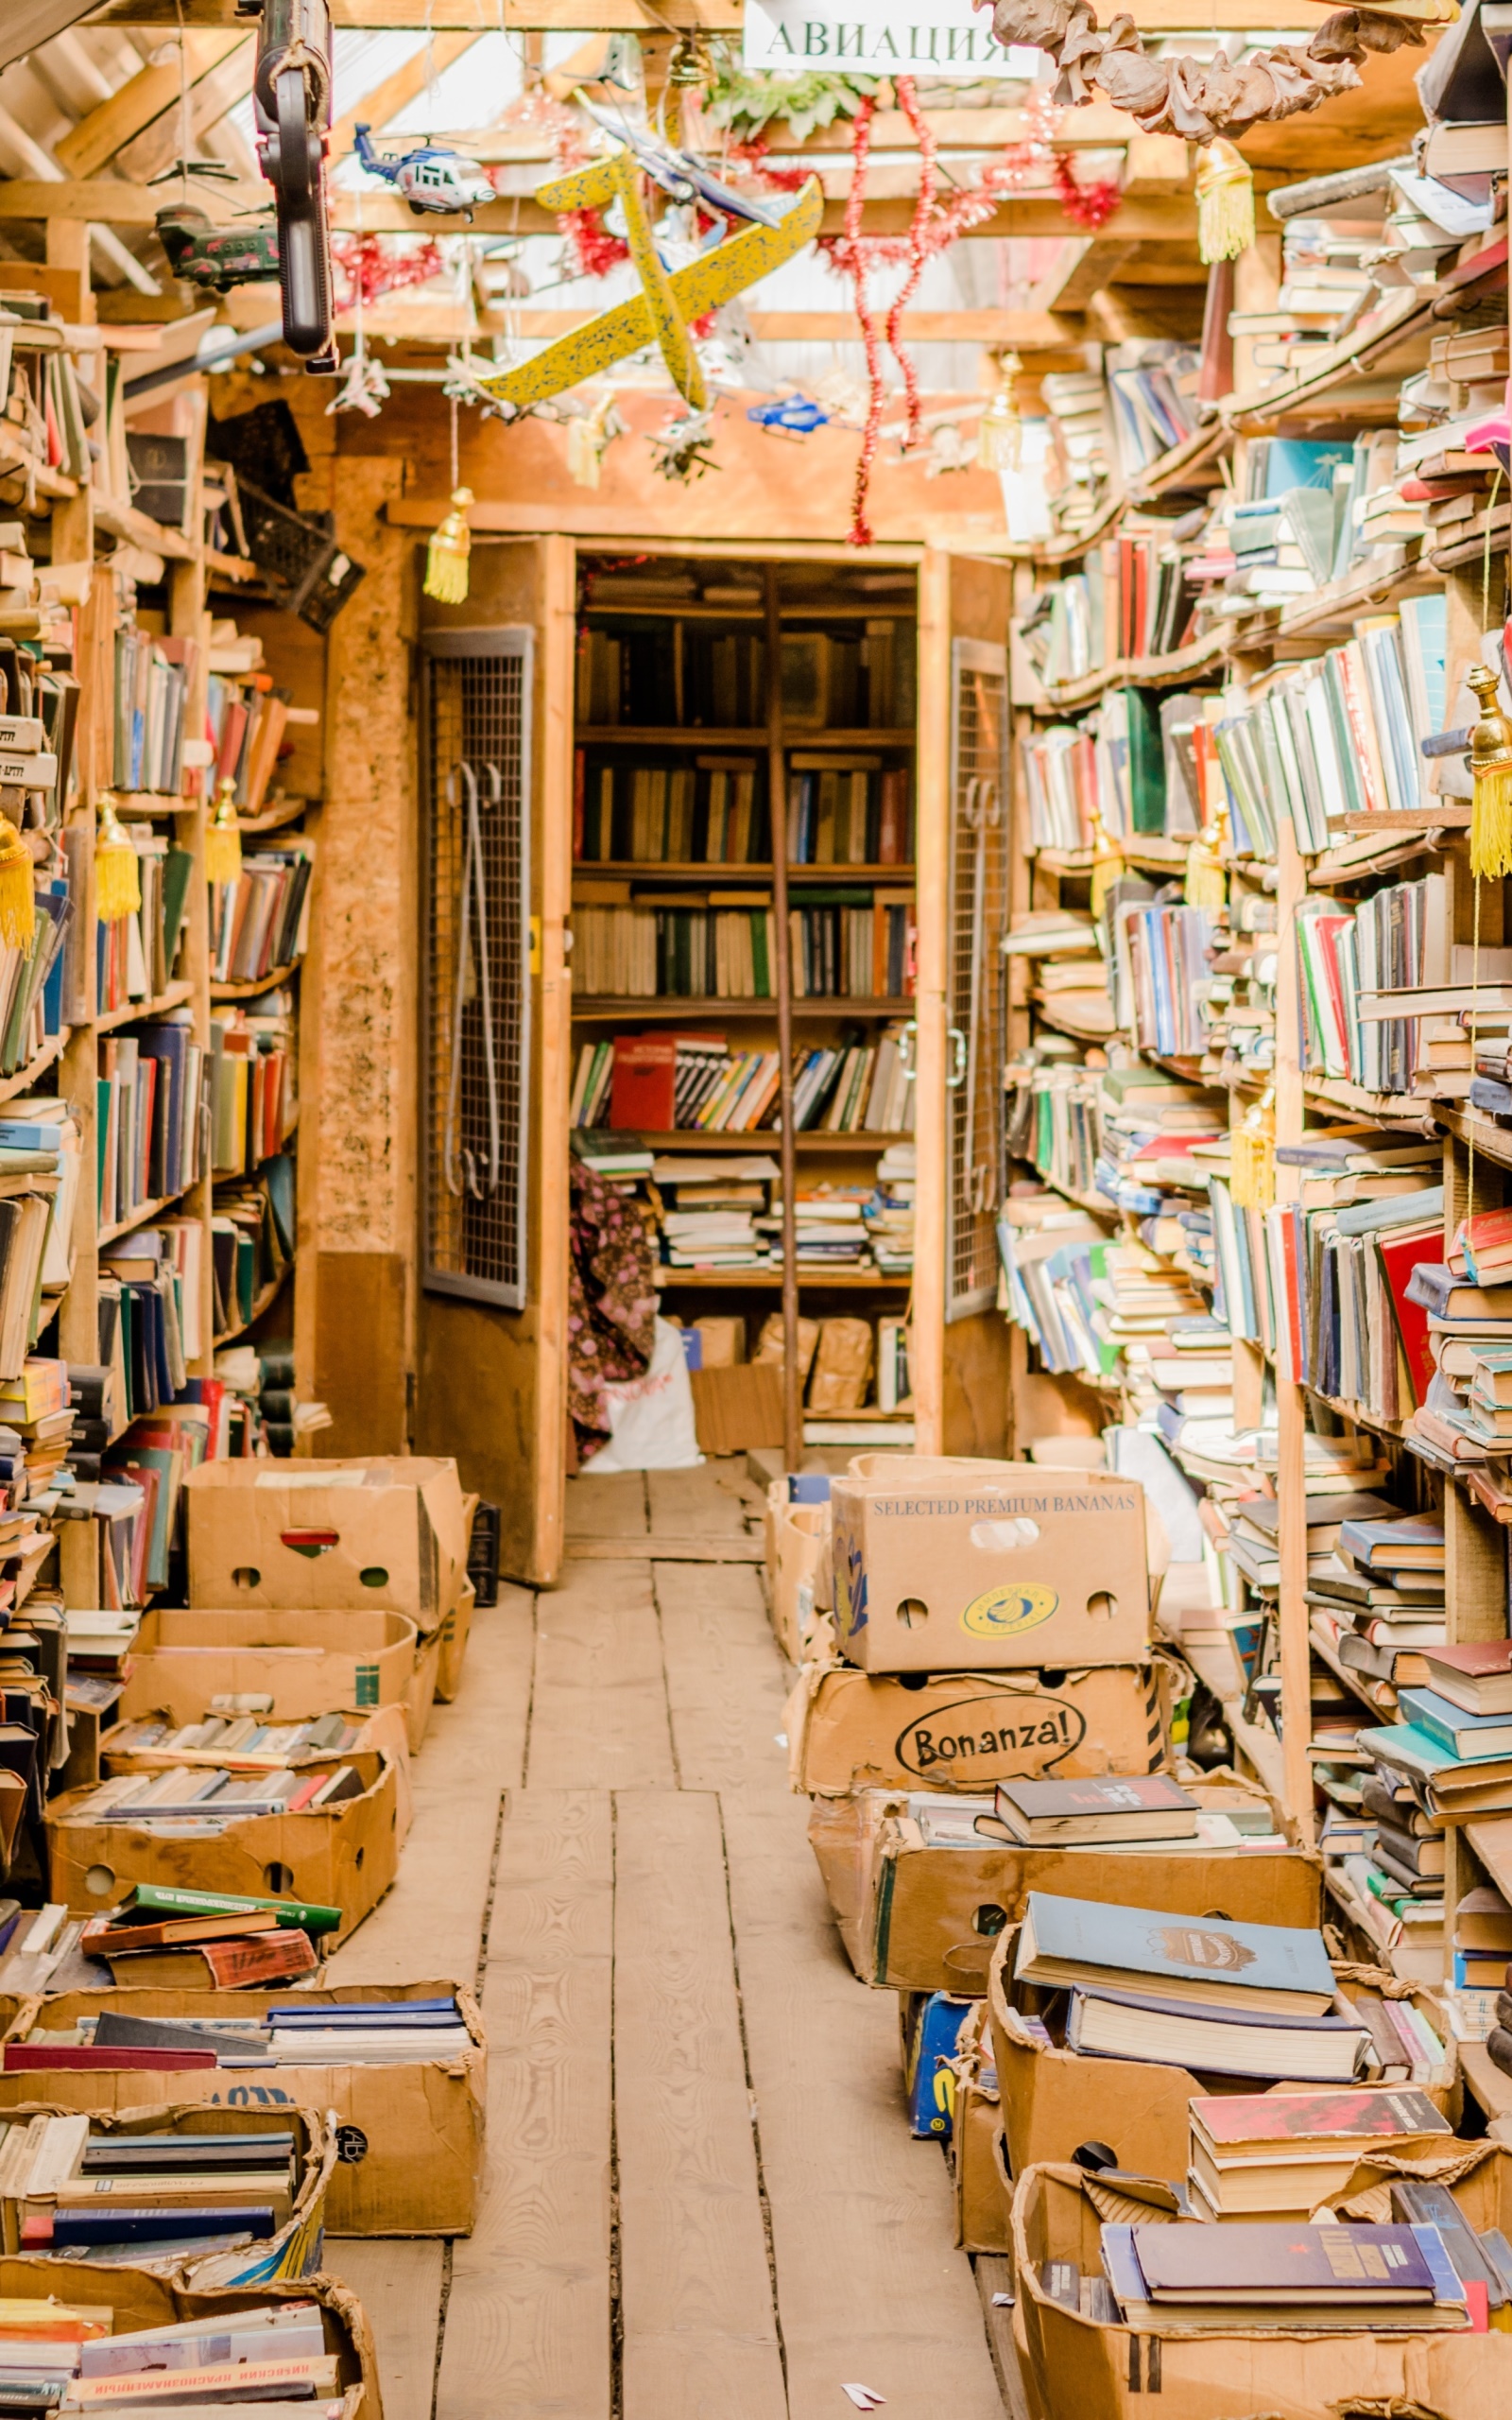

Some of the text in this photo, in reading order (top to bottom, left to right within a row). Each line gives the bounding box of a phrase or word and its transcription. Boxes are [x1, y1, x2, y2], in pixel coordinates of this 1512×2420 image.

[766, 20, 1012, 66] АВИАЦИЯ
[874, 1494, 1135, 1516] SELECTED PREMIUM BANANAS
[915, 1710, 1071, 1767] Bonanza!
